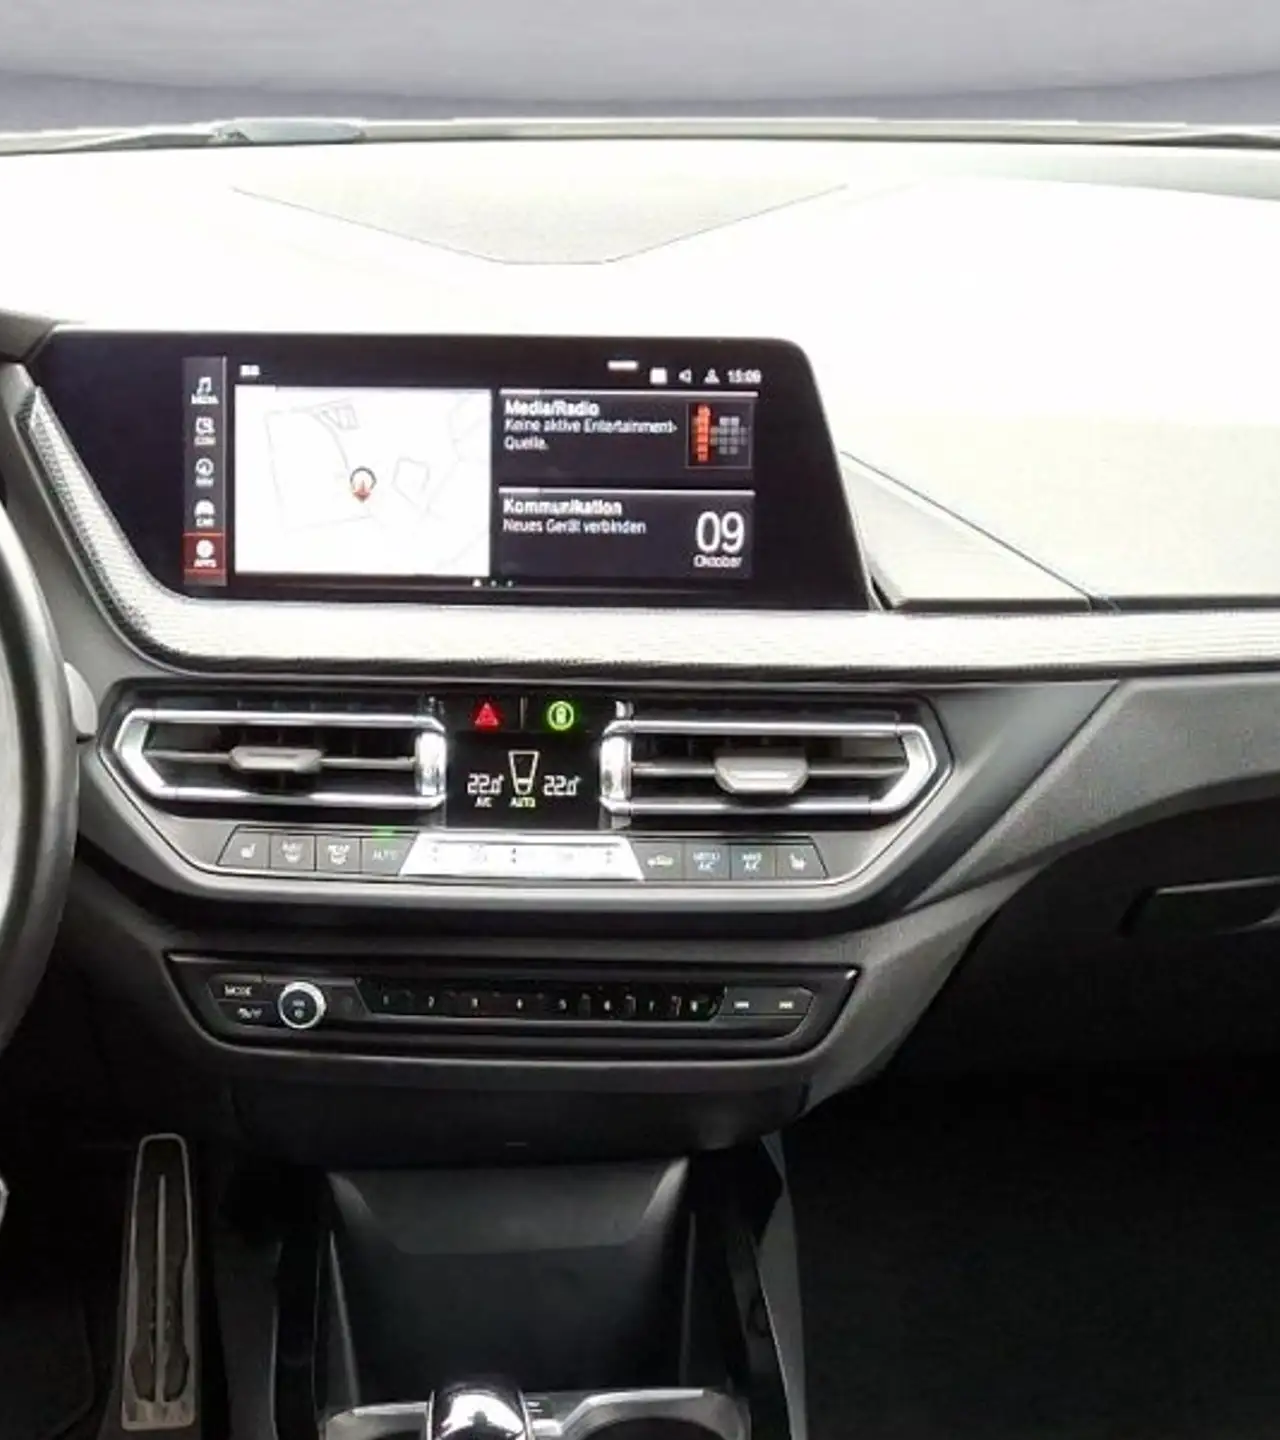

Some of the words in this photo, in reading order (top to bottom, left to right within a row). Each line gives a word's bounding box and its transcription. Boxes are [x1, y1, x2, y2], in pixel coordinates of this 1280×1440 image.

[504, 400, 601, 417] Media/Radio
[504, 419, 542, 433] Keine
[544, 419, 581, 433] aktive
[503, 499, 622, 516] Kommunikation
[503, 518, 543, 532] Neues
[545, 518, 580, 534] Gerät
[583, 518, 647, 534] verbinden
[695, 511, 745, 553] 09
[693, 554, 743, 569] Oktober
[509, 797, 536, 808] AUTO
